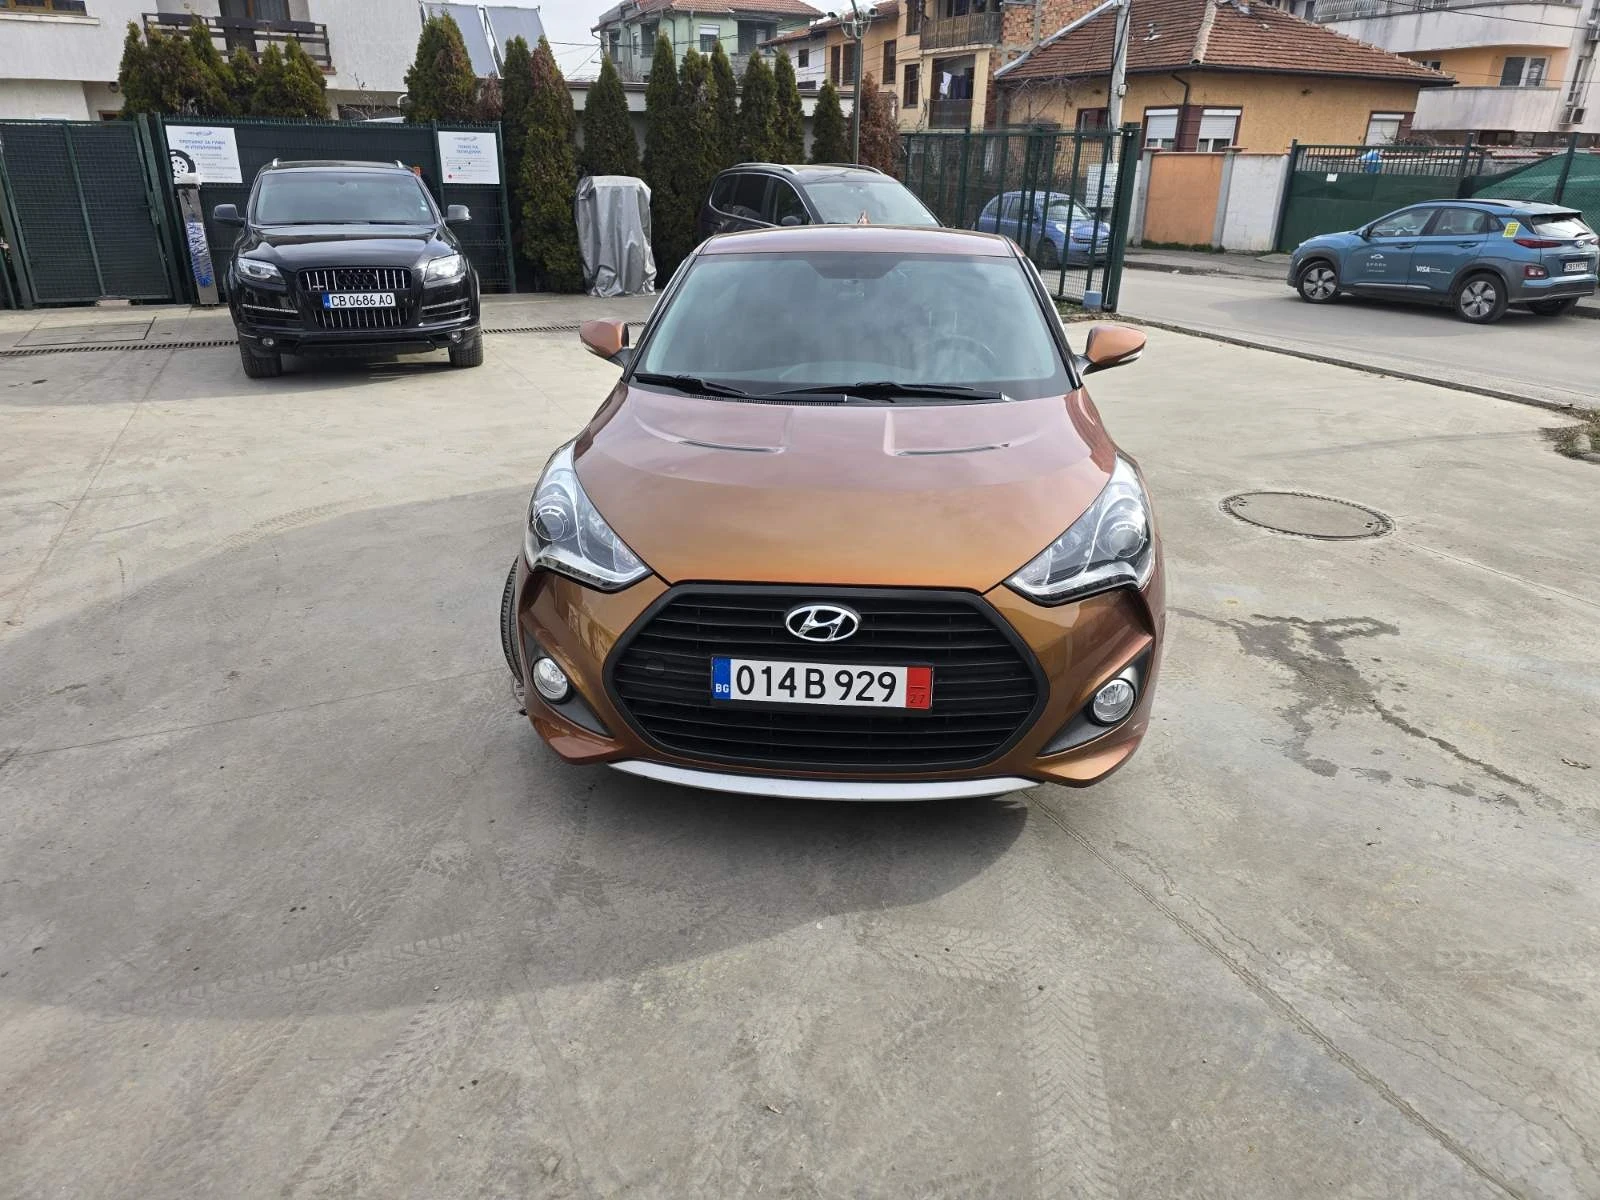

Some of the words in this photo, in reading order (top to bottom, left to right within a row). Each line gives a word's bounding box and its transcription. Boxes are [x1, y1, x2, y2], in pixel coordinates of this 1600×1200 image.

[1416, 265, 1430, 273] VISA
[332, 296, 347, 306] CB
[349, 294, 376, 305] 0686
[379, 294, 393, 305] AO
[715, 683, 730, 693] BG
